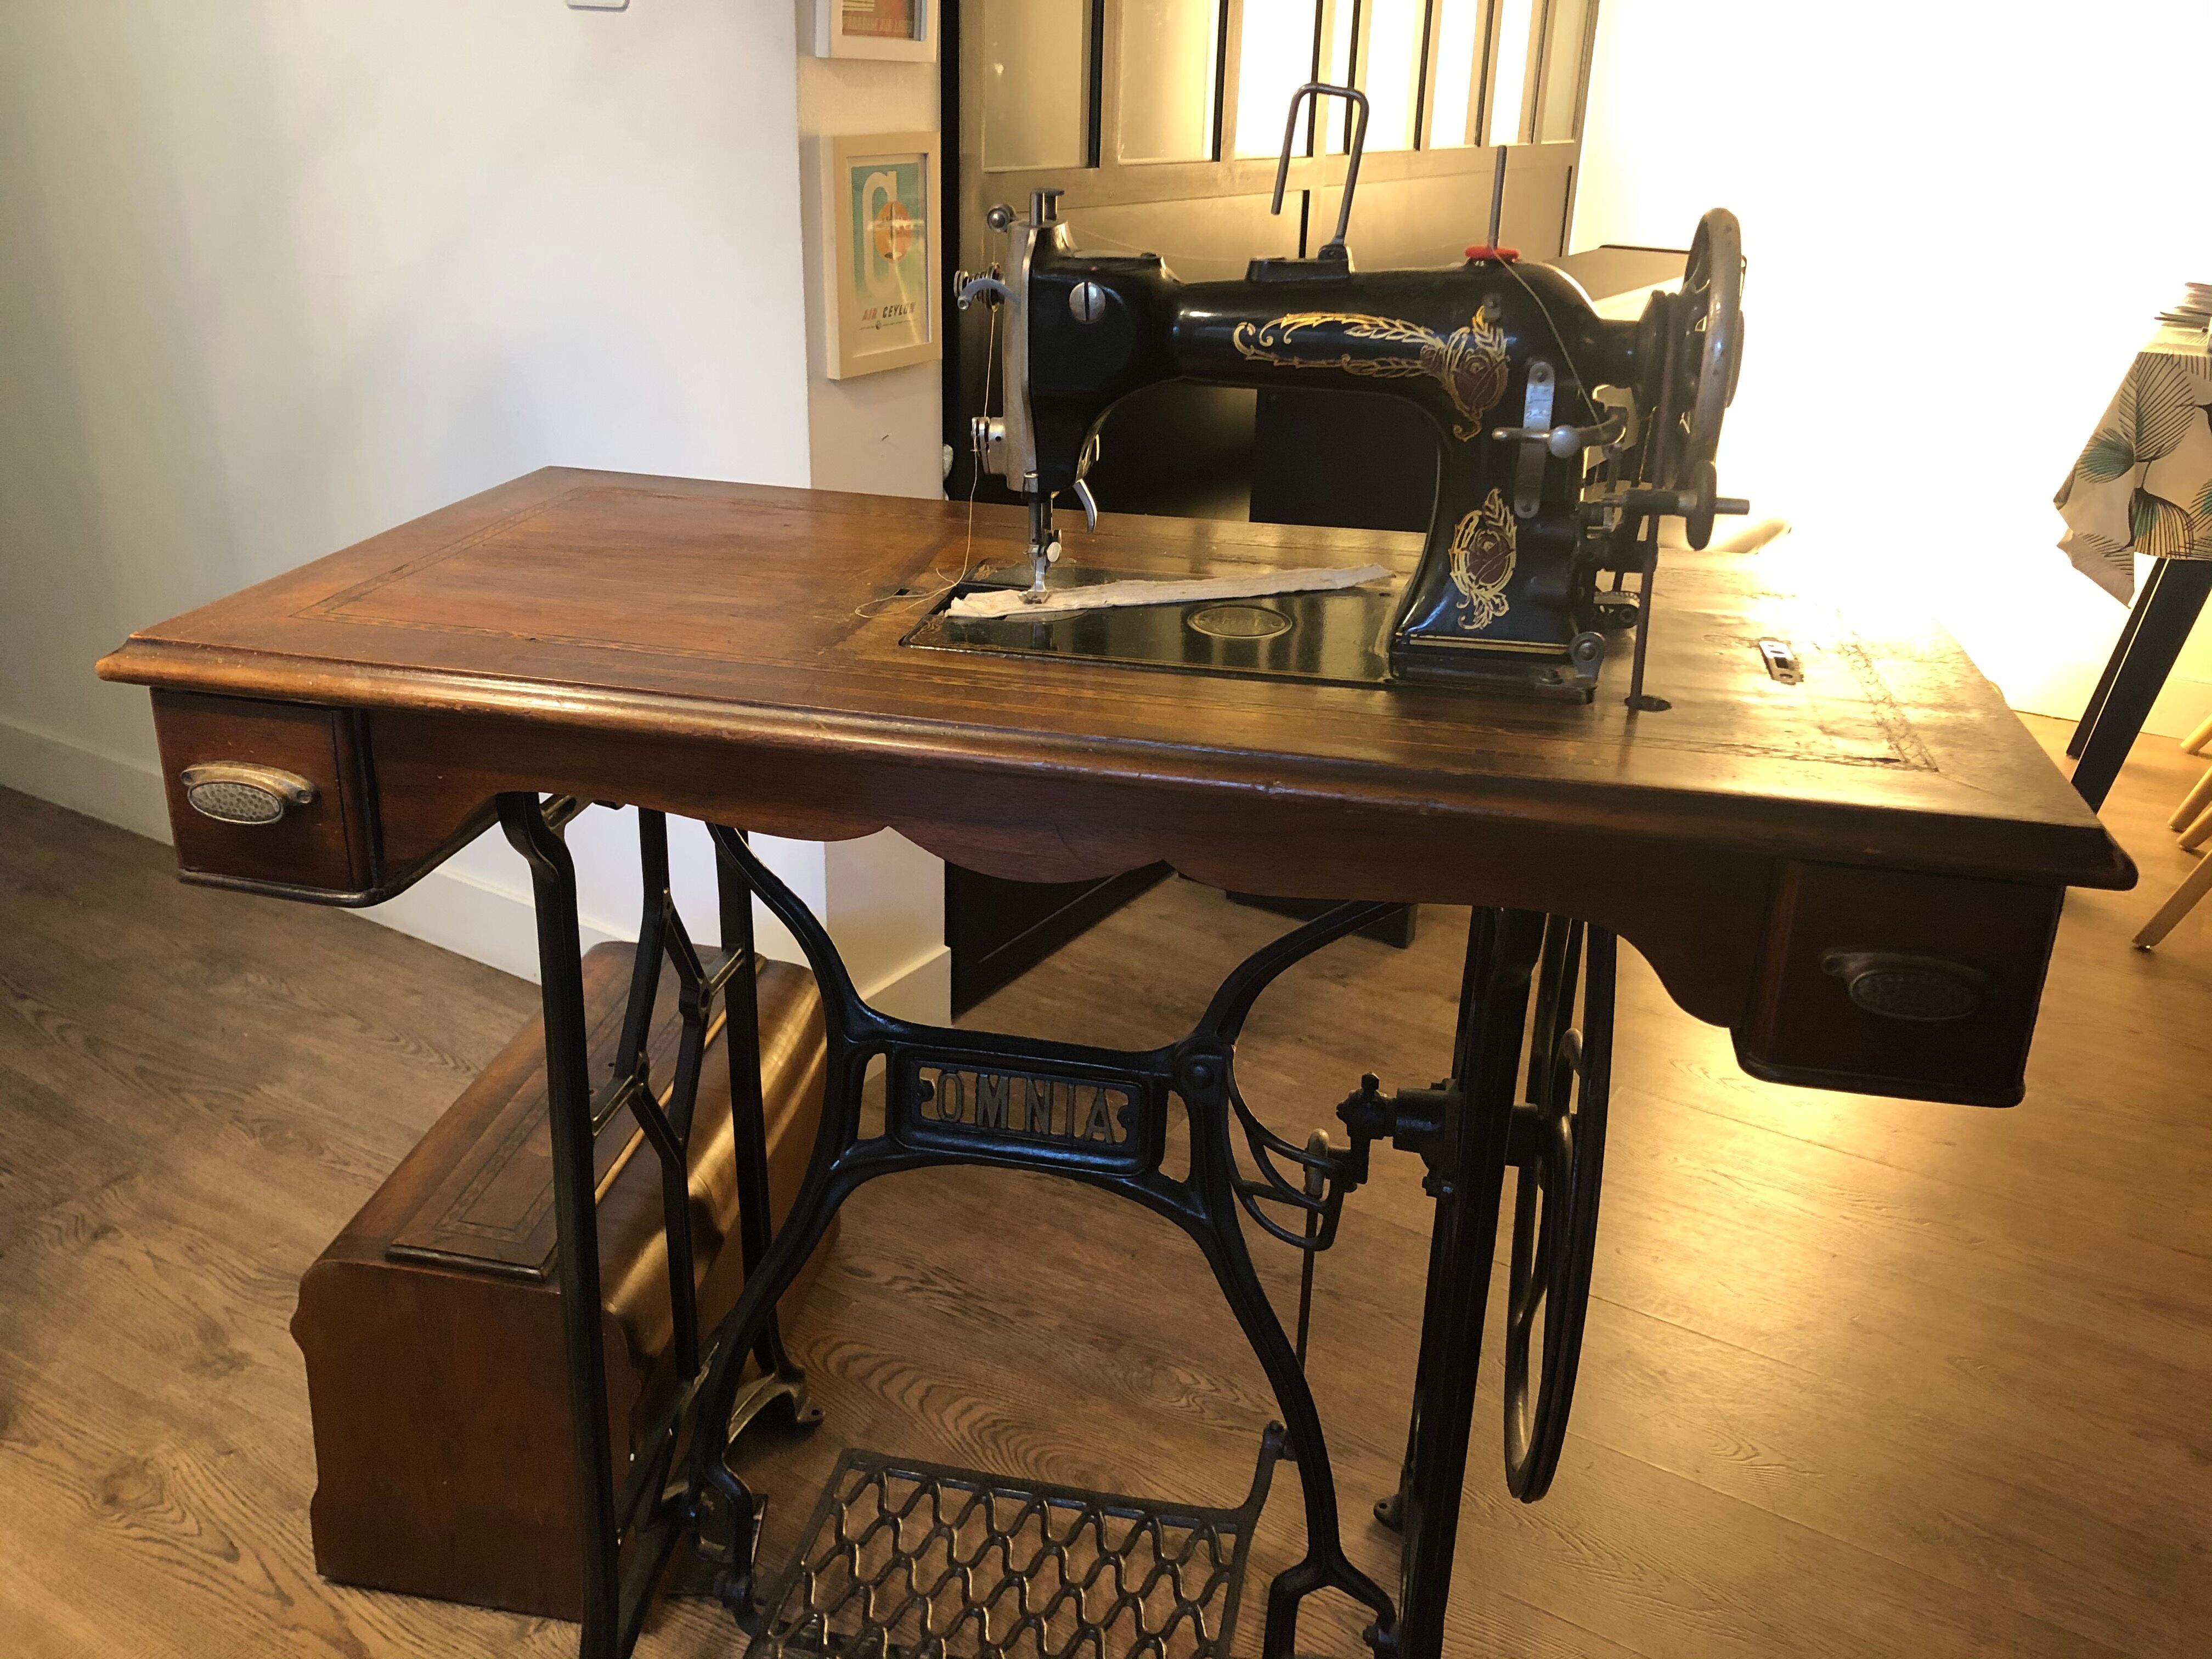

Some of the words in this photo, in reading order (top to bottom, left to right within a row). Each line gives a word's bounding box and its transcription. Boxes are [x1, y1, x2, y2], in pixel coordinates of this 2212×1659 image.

[862, 308, 878, 320] AIR
[882, 302, 916, 318] CEYLON
[938, 1071, 1114, 1144] OMNIA
